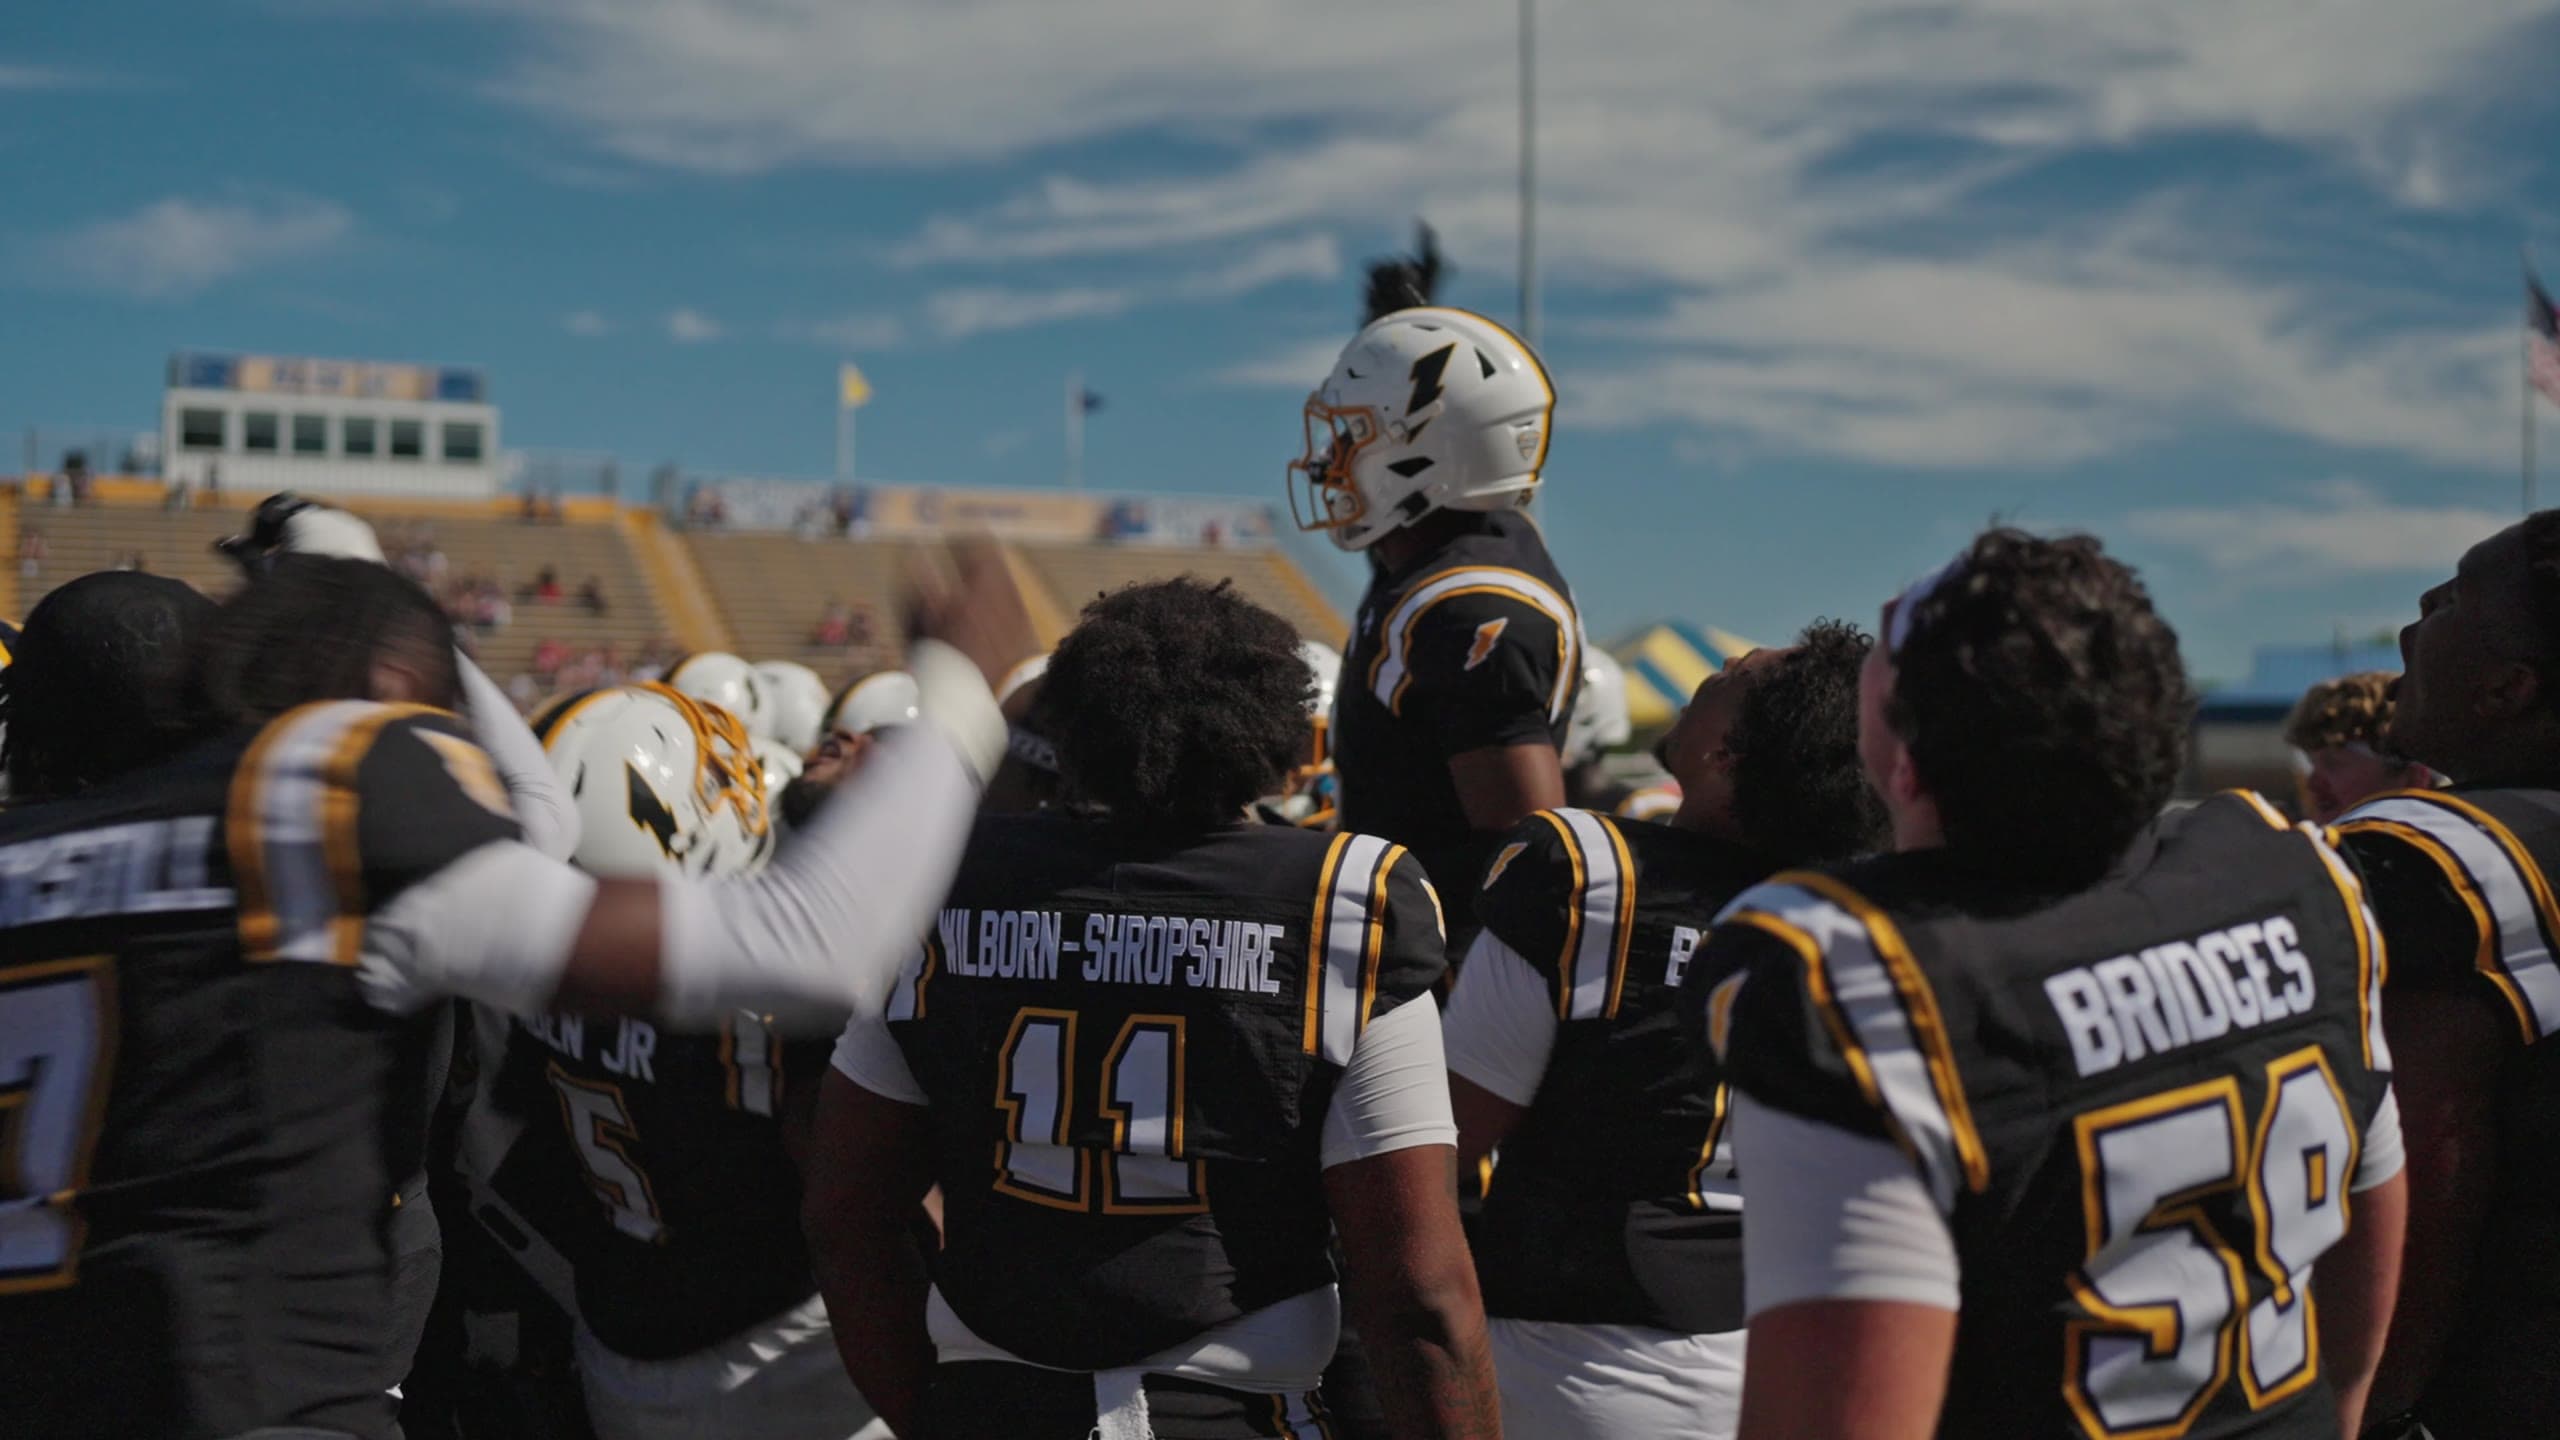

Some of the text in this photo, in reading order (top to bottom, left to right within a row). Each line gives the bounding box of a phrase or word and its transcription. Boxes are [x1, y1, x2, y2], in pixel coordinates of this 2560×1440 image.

[938, 908, 1285, 994] WILBORN-SHROPSHIRE
[2045, 916, 2317, 1078] BRIDGES
[600, 1017, 657, 1084] JR
[993, 1006, 1211, 1217] 11
[546, 1058, 668, 1247] 5
[2063, 1043, 2360, 1440] 59
